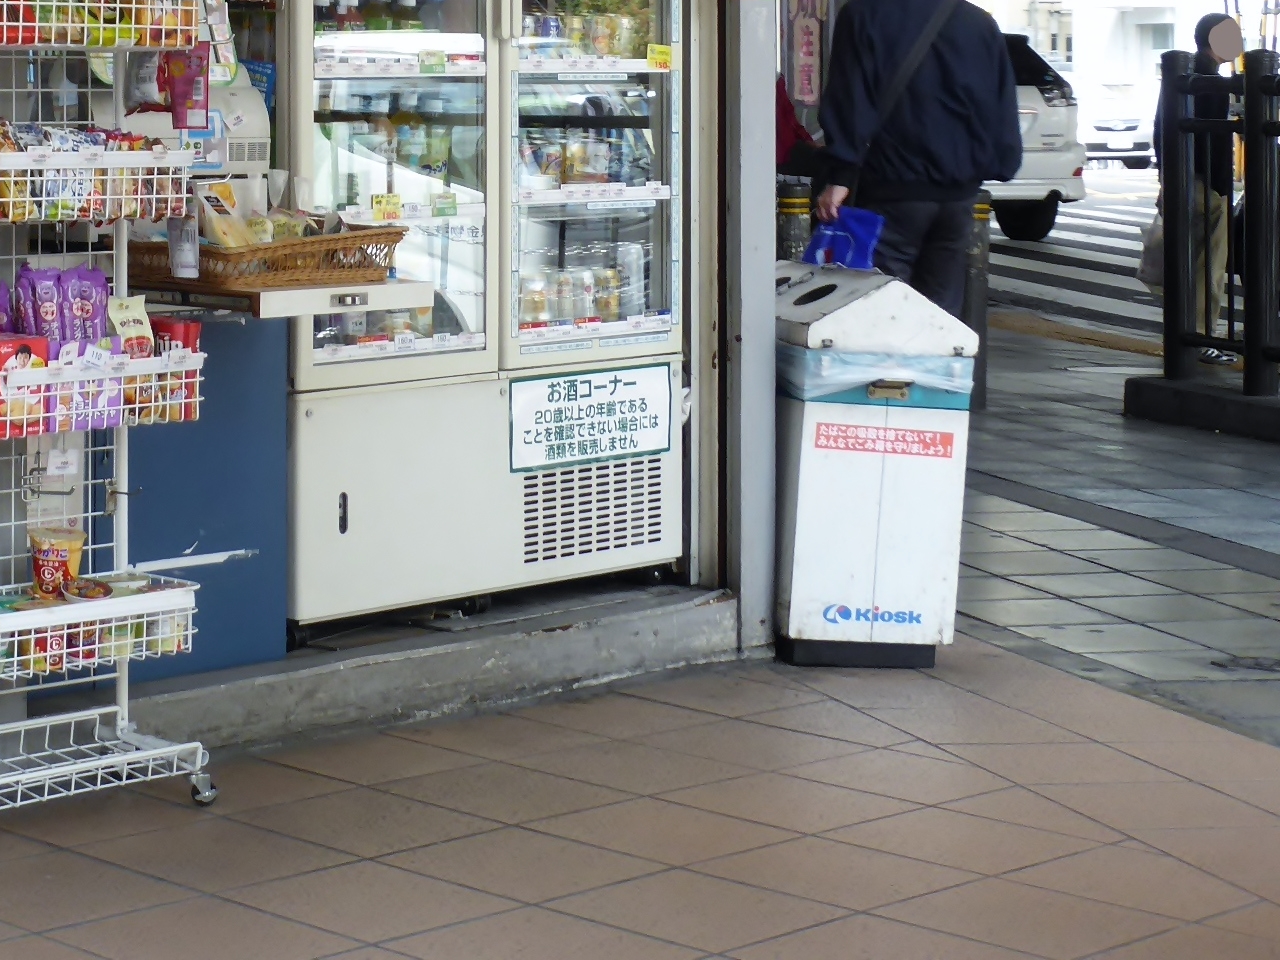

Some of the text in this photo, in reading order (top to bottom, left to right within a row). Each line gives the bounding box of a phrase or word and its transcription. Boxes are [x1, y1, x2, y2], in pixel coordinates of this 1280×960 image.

[547, 375, 637, 403] お酒コーナー
[534, 397, 648, 425] 20歳以上の年齢である
[523, 413, 659, 445] ことを確認できない場合には
[544, 434, 639, 461] 酒類を販売しません
[816, 435, 953, 457] みんなでごみ箱を守りましょう!
[855, 605, 922, 625] Kiosk
